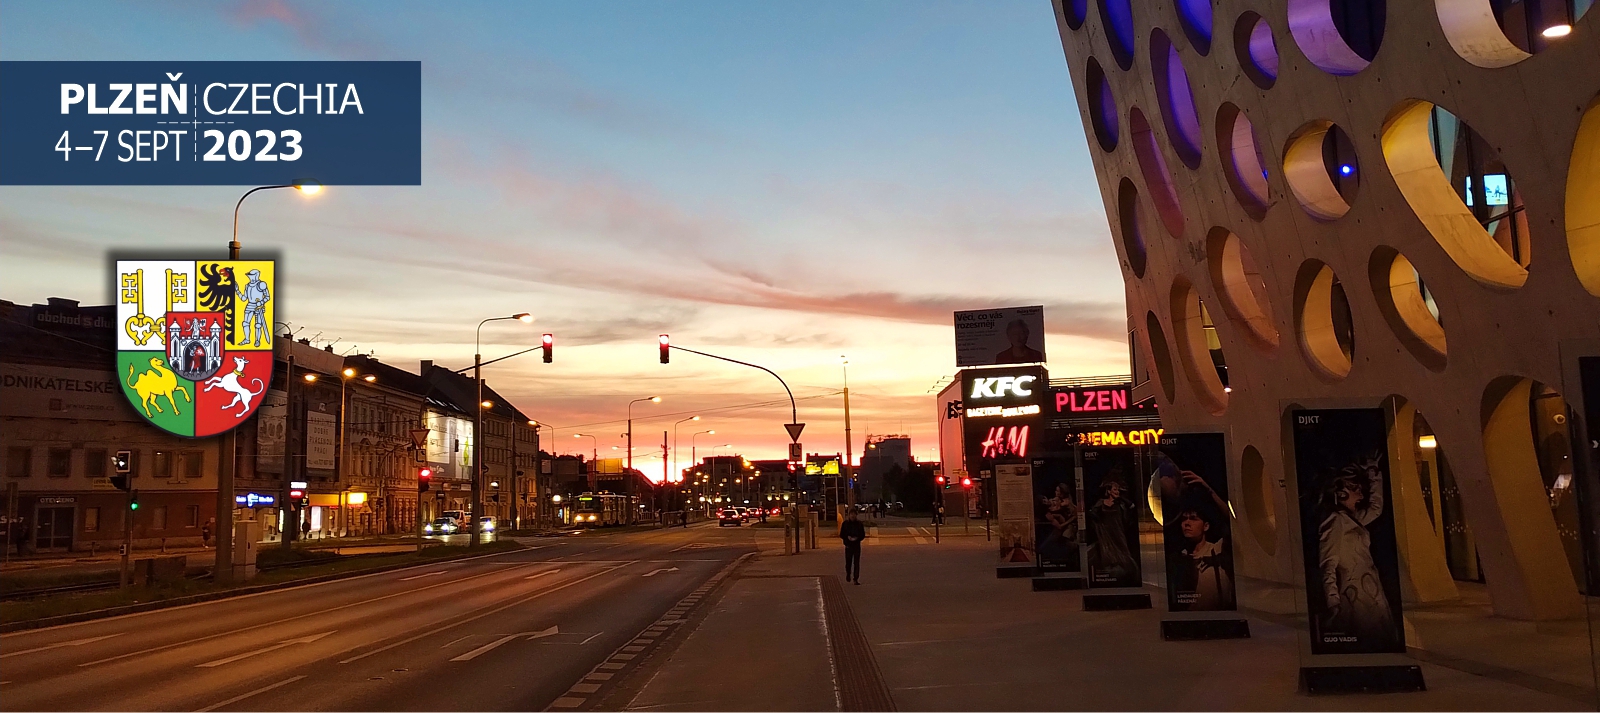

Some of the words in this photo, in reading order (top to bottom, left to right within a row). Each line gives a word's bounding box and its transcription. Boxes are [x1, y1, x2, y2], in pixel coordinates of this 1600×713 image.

[37, 309, 81, 326] obchod
[83, 317, 93, 329] s
[989, 311, 1003, 319] vás
[0, 374, 114, 394] DNIKATELSKÉ
[970, 375, 1034, 399] KFC
[1055, 389, 1127, 413] PLZEN
[1297, 415, 1320, 426] DJKT
[981, 425, 1029, 458] H&M
[1129, 428, 1164, 445] CITY
[1161, 437, 1178, 446] DJKT
